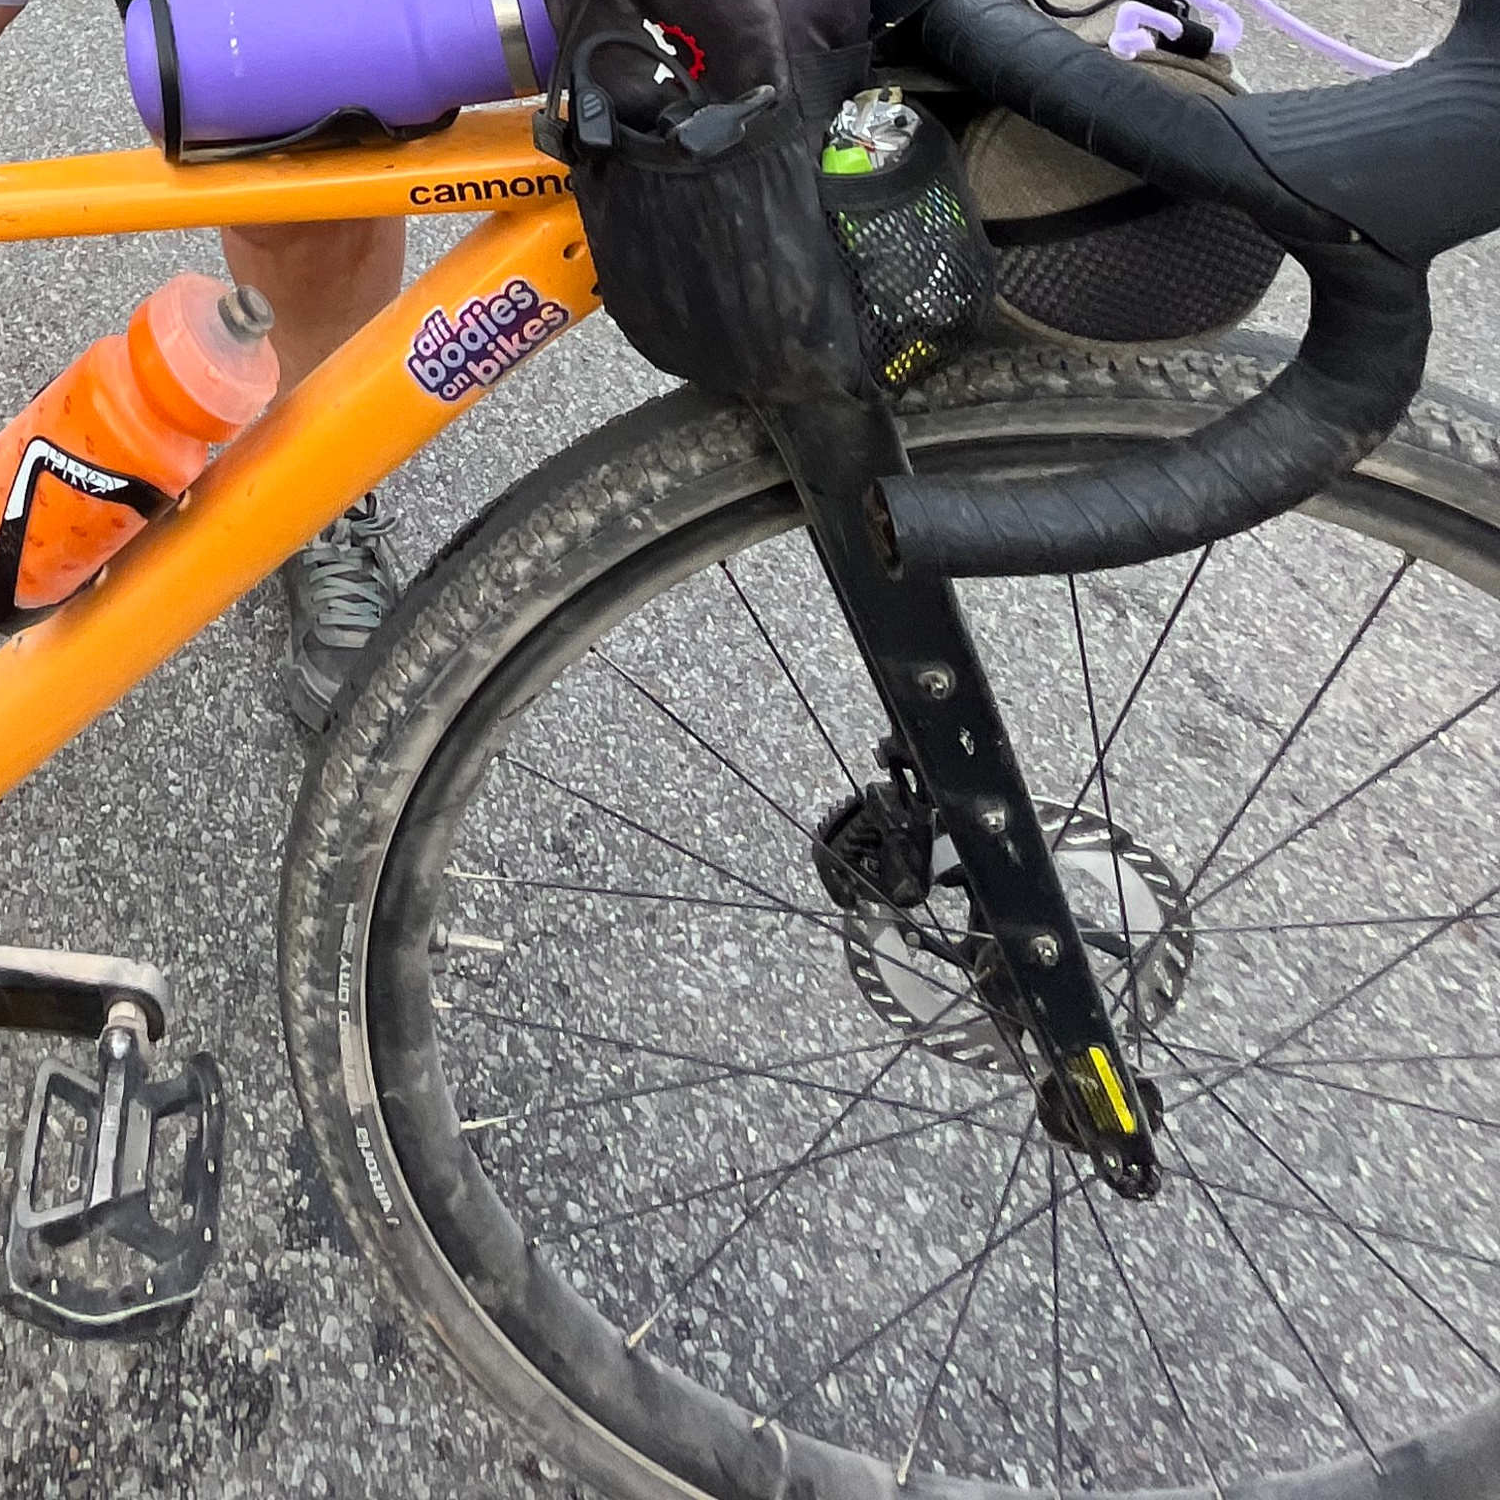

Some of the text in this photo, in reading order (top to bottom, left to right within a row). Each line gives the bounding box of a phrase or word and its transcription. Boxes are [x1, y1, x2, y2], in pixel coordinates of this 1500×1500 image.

[410, 282, 534, 389] bodies
[415, 311, 451, 357] all
[442, 305, 565, 399] on bikes
